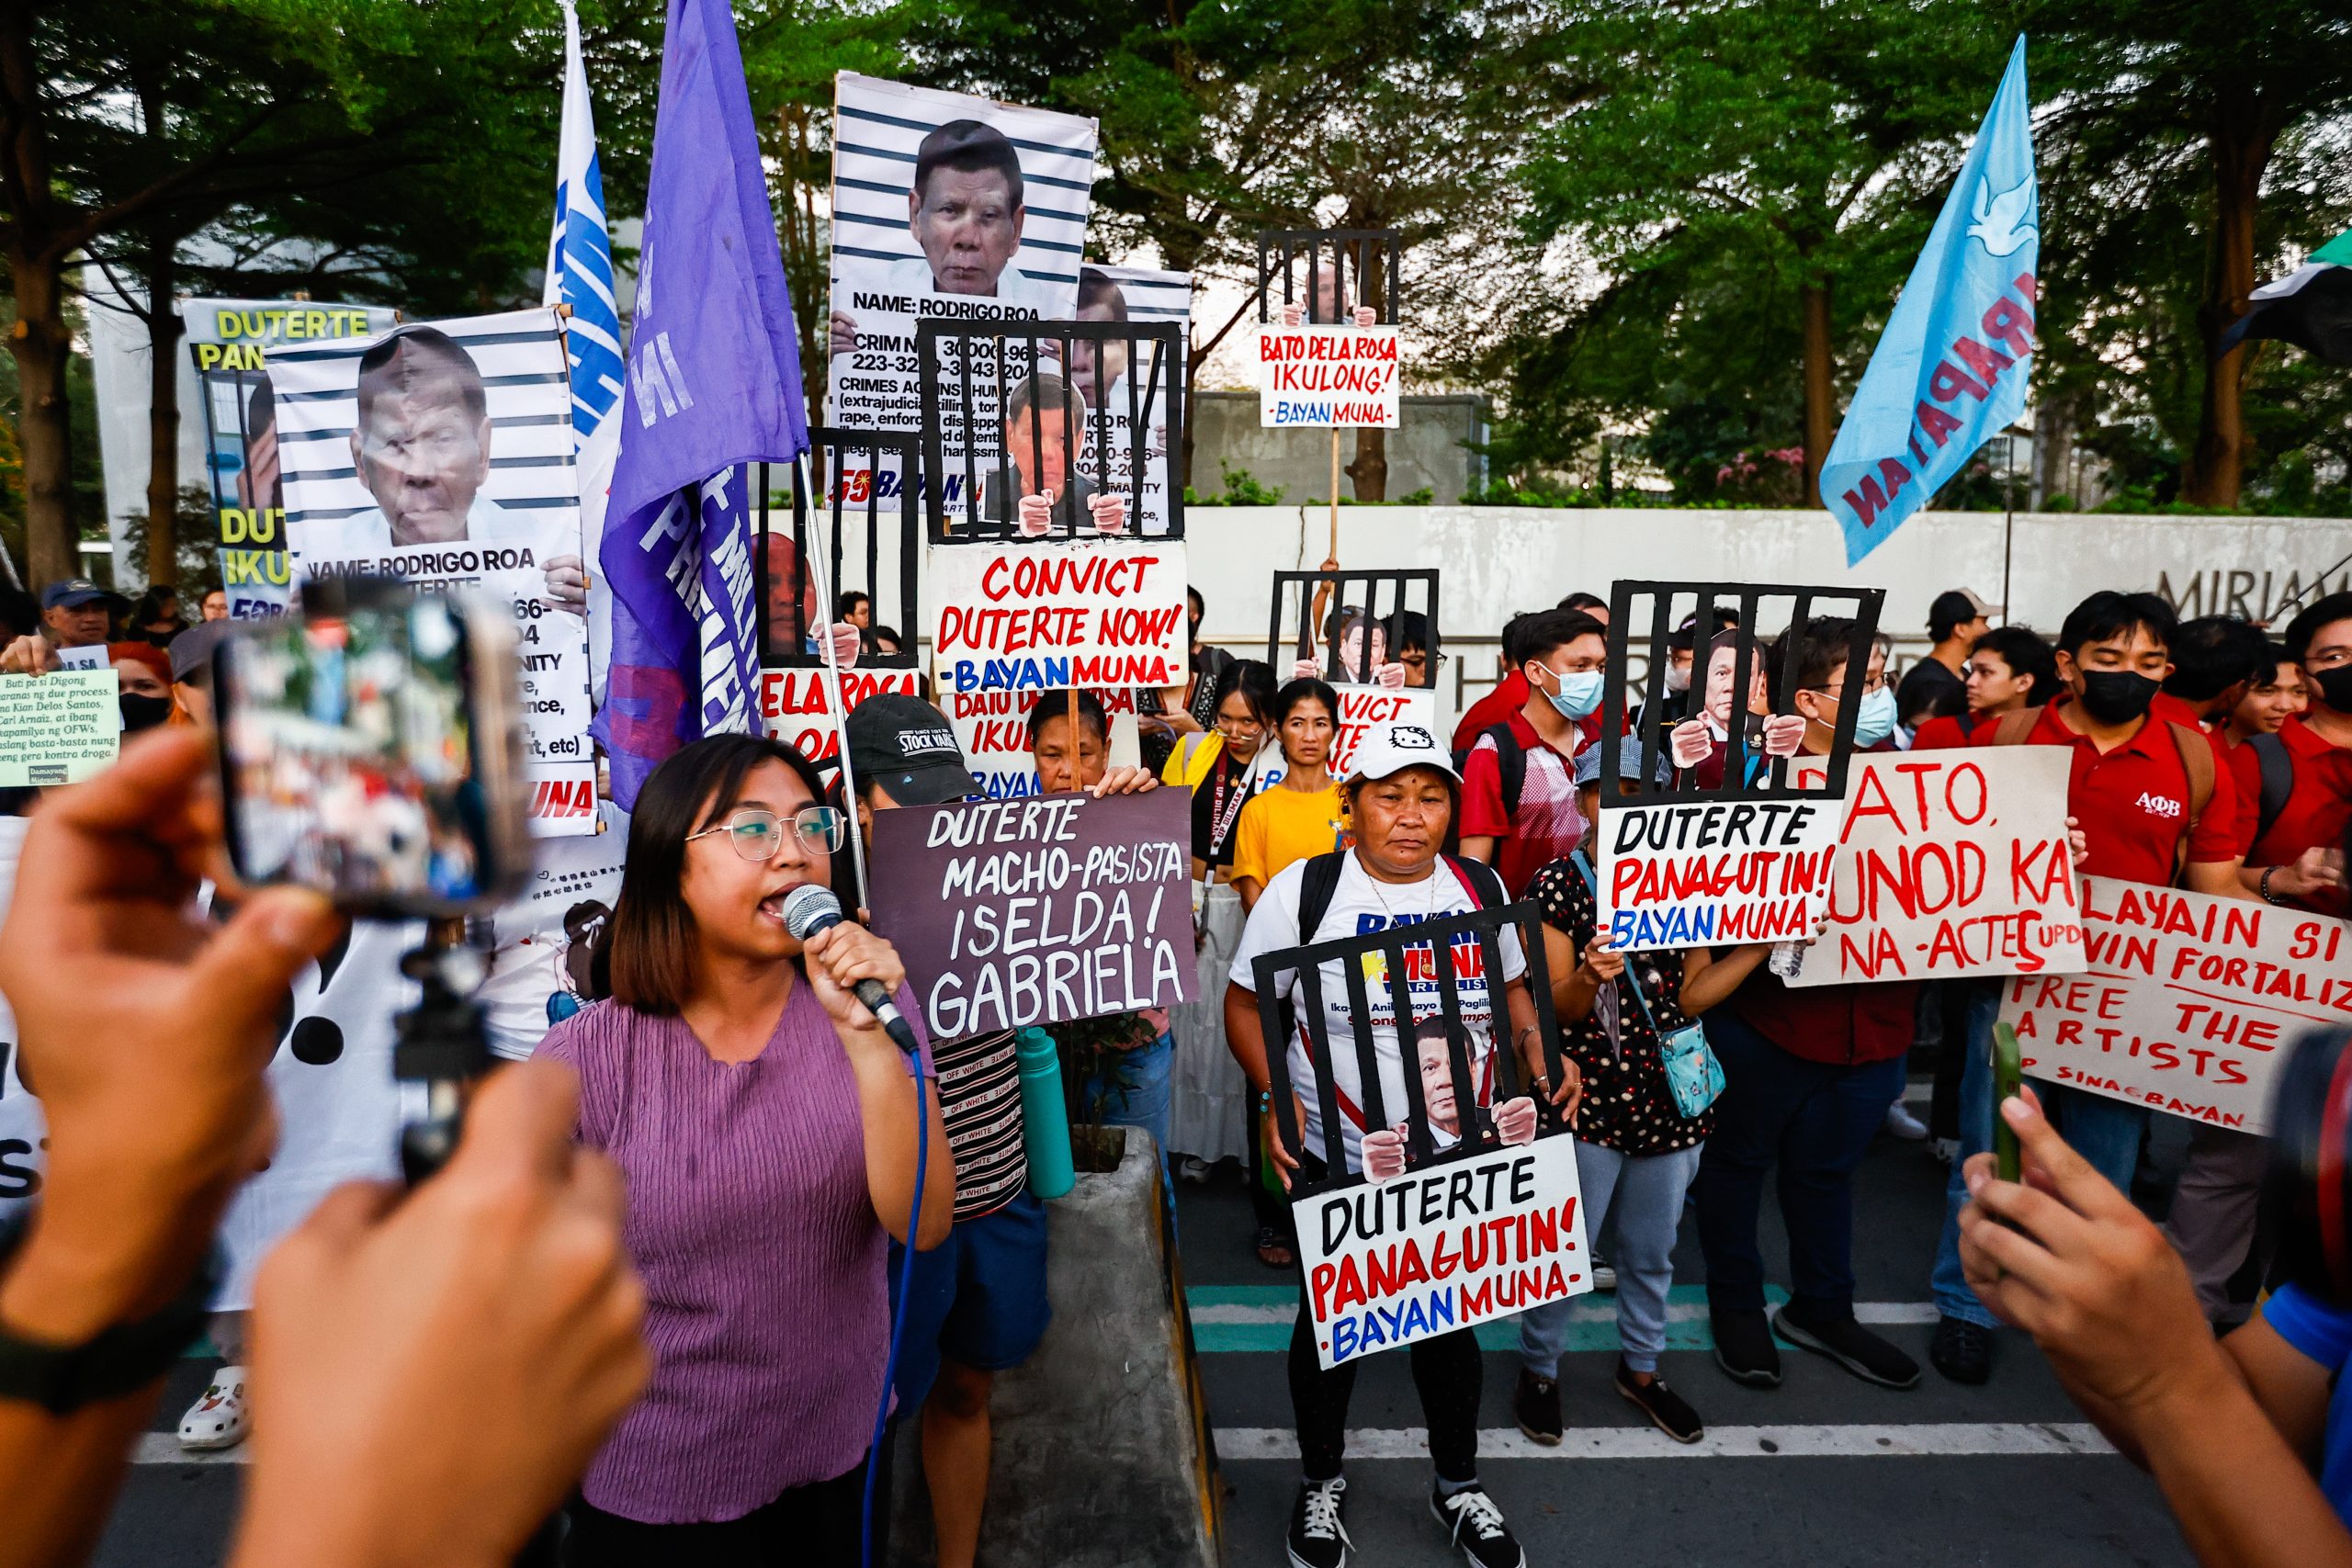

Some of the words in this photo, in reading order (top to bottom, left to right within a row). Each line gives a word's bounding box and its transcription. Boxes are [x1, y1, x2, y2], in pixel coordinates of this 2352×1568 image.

[853, 292, 916, 314] NAME:
[920, 299, 1001, 321] RODRIGO
[1003, 307, 1040, 321] ROA
[217, 310, 368, 339] DUTERTE
[853, 333, 904, 353] CRIM
[1261, 335, 1305, 362] BATO
[1356, 335, 1397, 362] ROSA
[840, 377, 898, 393] CRIMES
[1274, 363, 1395, 395] IKULONG!
[839, 412, 875, 427] rape,
[379, 551, 479, 577] RODRIGO
[483, 548, 535, 570] ROA
[981, 555, 1159, 602] CONVICT
[937, 605, 1089, 655] DUTERTE
[1098, 603, 1183, 649] NOW!
[40, 677, 47, 686] si
[50, 676, 86, 687] Digong
[33, 692, 45, 700] ng
[48, 689, 66, 698] due
[13, 703, 33, 713] Kian
[36, 702, 62, 711] Delos
[56, 714, 66, 722] at
[69, 712, 97, 723] ibang
[29, 738, 88, 749] basta-basta
[91, 737, 116, 747] nung
[48, 728, 60, 736] ng
[899, 734, 934, 752] STOCK
[21, 752, 41, 762] gera
[44, 750, 78, 760] kontra
[548, 736, 580, 755] etc)
[1216, 786, 1224, 798] UP
[926, 798, 1086, 849] DUTERTE
[1217, 827, 1227, 839] UP
[1613, 804, 1815, 855] DUTERTE
[942, 840, 1183, 902] MACHO-PASISTA
[1611, 843, 1836, 909] PANAGUTIN!
[2010, 838, 2075, 908] KA
[2080, 878, 2262, 949] LAYAIN
[2289, 921, 2342, 963] SI
[1840, 927, 1907, 980] NA
[2038, 924, 2082, 948] UPD
[928, 938, 1184, 1039] GABRIELA
[2011, 975, 2129, 1021] FREE
[2176, 1003, 2280, 1052] THE
[2014, 1010, 2248, 1085] ARTISTS
[946, 1069, 959, 1080] OFF
[962, 1060, 984, 1075] WHITE
[951, 1103, 963, 1114] OFF
[966, 1093, 989, 1108] WHITE
[953, 1135, 965, 1145] OFF
[968, 1126, 992, 1140] WHITE
[969, 1156, 991, 1169] WHITE
[966, 1185, 990, 1197] WHITE
[1321, 1155, 1536, 1258] DUTERTE
[1311, 1196, 1577, 1324] PANAGUTIN!
